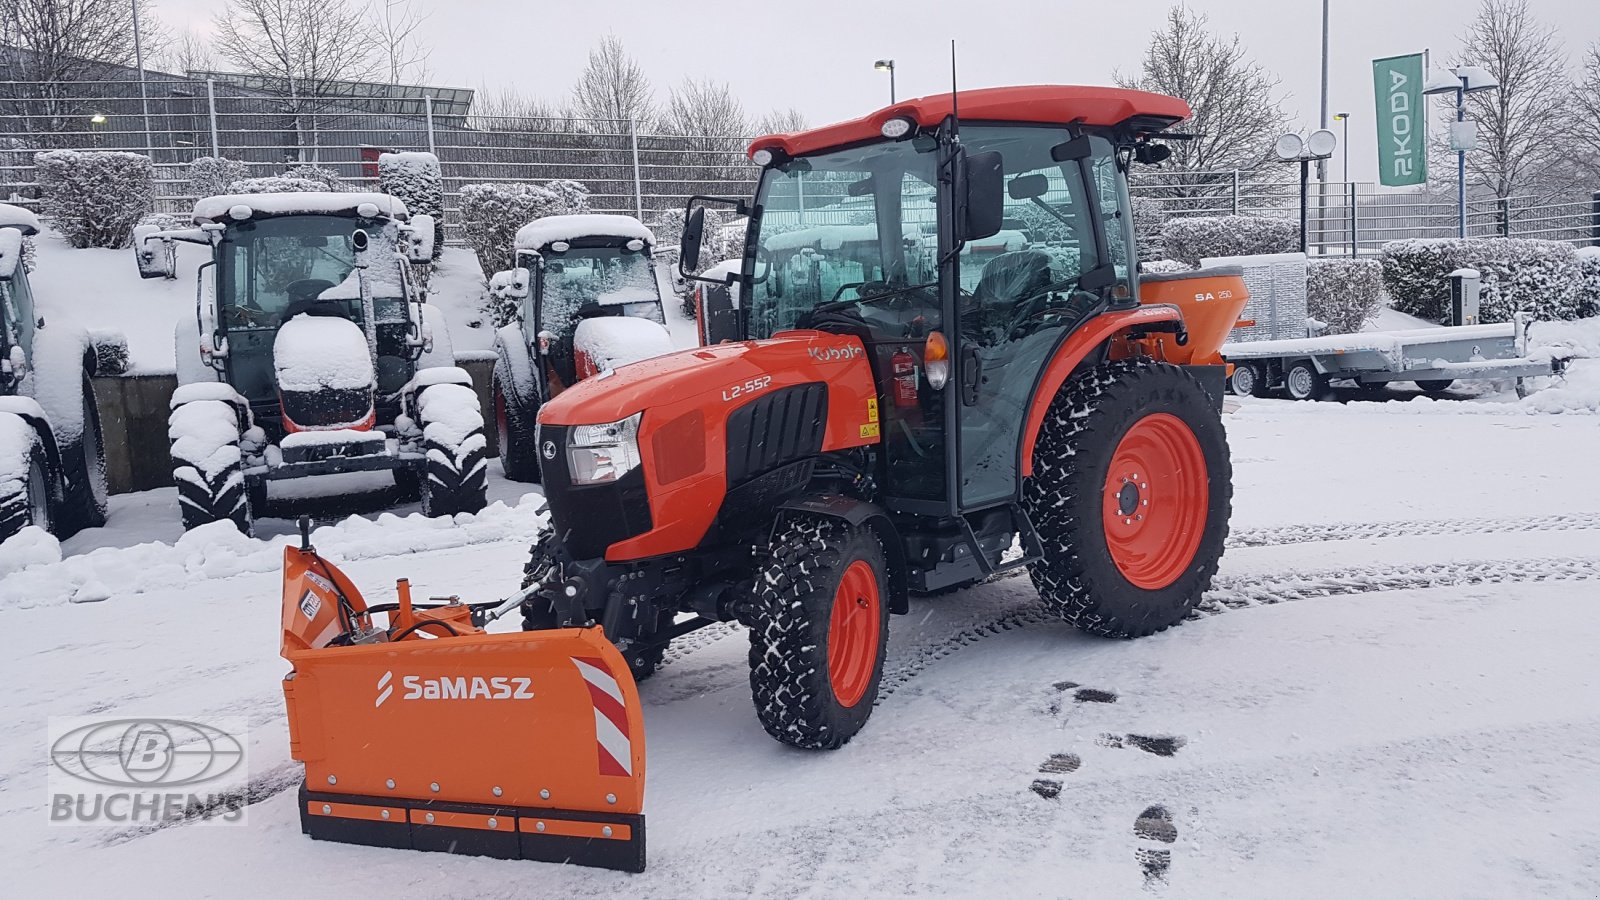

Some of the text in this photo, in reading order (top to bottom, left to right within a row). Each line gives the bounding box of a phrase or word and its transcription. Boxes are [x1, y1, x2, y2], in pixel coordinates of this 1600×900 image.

[1194, 290, 1233, 302] SA 250
[807, 344, 865, 361] Kubota
[722, 375, 773, 402] L2-552
[402, 675, 535, 700] SaMASZ
